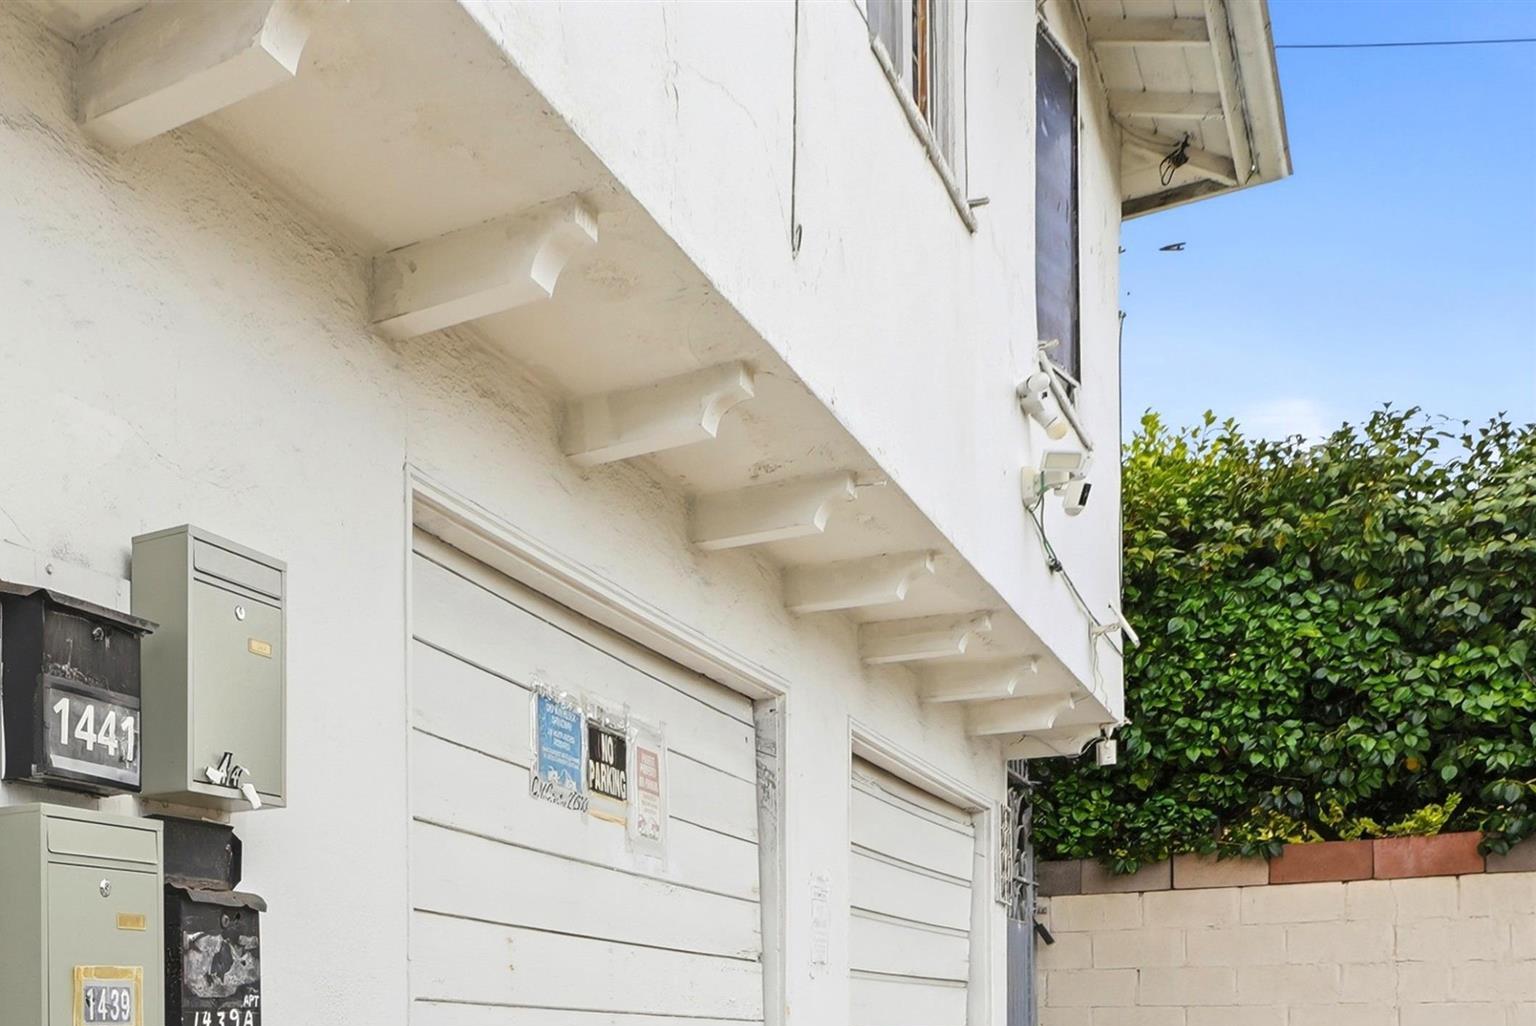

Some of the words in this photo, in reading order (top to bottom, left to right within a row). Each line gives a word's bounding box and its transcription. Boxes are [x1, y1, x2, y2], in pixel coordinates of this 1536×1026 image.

[53, 697, 135, 762] 1441
[600, 732, 615, 766] NO
[588, 759, 627, 801] PARKING
[85, 987, 131, 1022] 1439
[241, 994, 260, 1008] APT
